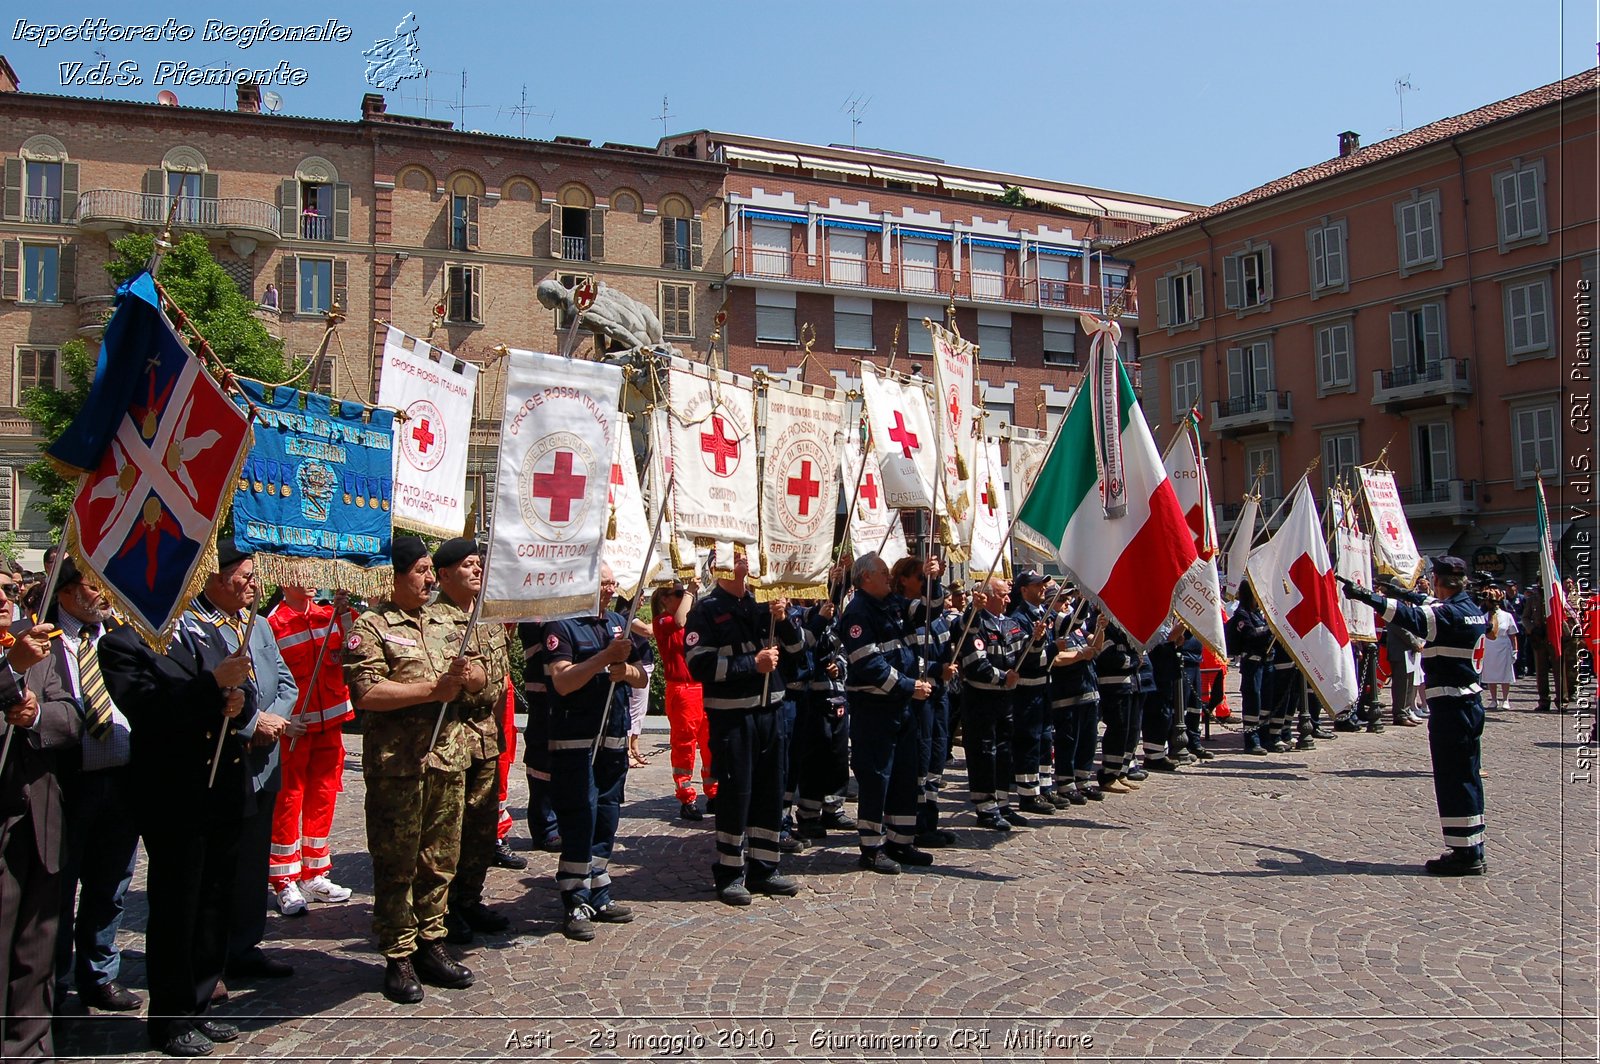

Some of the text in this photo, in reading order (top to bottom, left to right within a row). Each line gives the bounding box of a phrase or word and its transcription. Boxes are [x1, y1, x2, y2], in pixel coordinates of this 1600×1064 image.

[391, 358, 467, 397] CROCE ROSSA ITALIANA
[510, 386, 610, 446] CROCE ROSSA ITALIANA
[537, 441, 548, 453] DI
[767, 431, 788, 475] CROCE
[788, 420, 816, 438] ROSSA
[787, 449, 795, 461] DI
[1174, 470, 1198, 480] CRO
[403, 496, 434, 513] NOVARA
[423, 489, 449, 506] LOCALE
[451, 498, 457, 508] DI
[247, 522, 317, 546] SEZIONE
[346, 536, 381, 553] ASTI
[518, 544, 588, 558] COMITATO DI
[523, 570, 575, 586] ARONA
